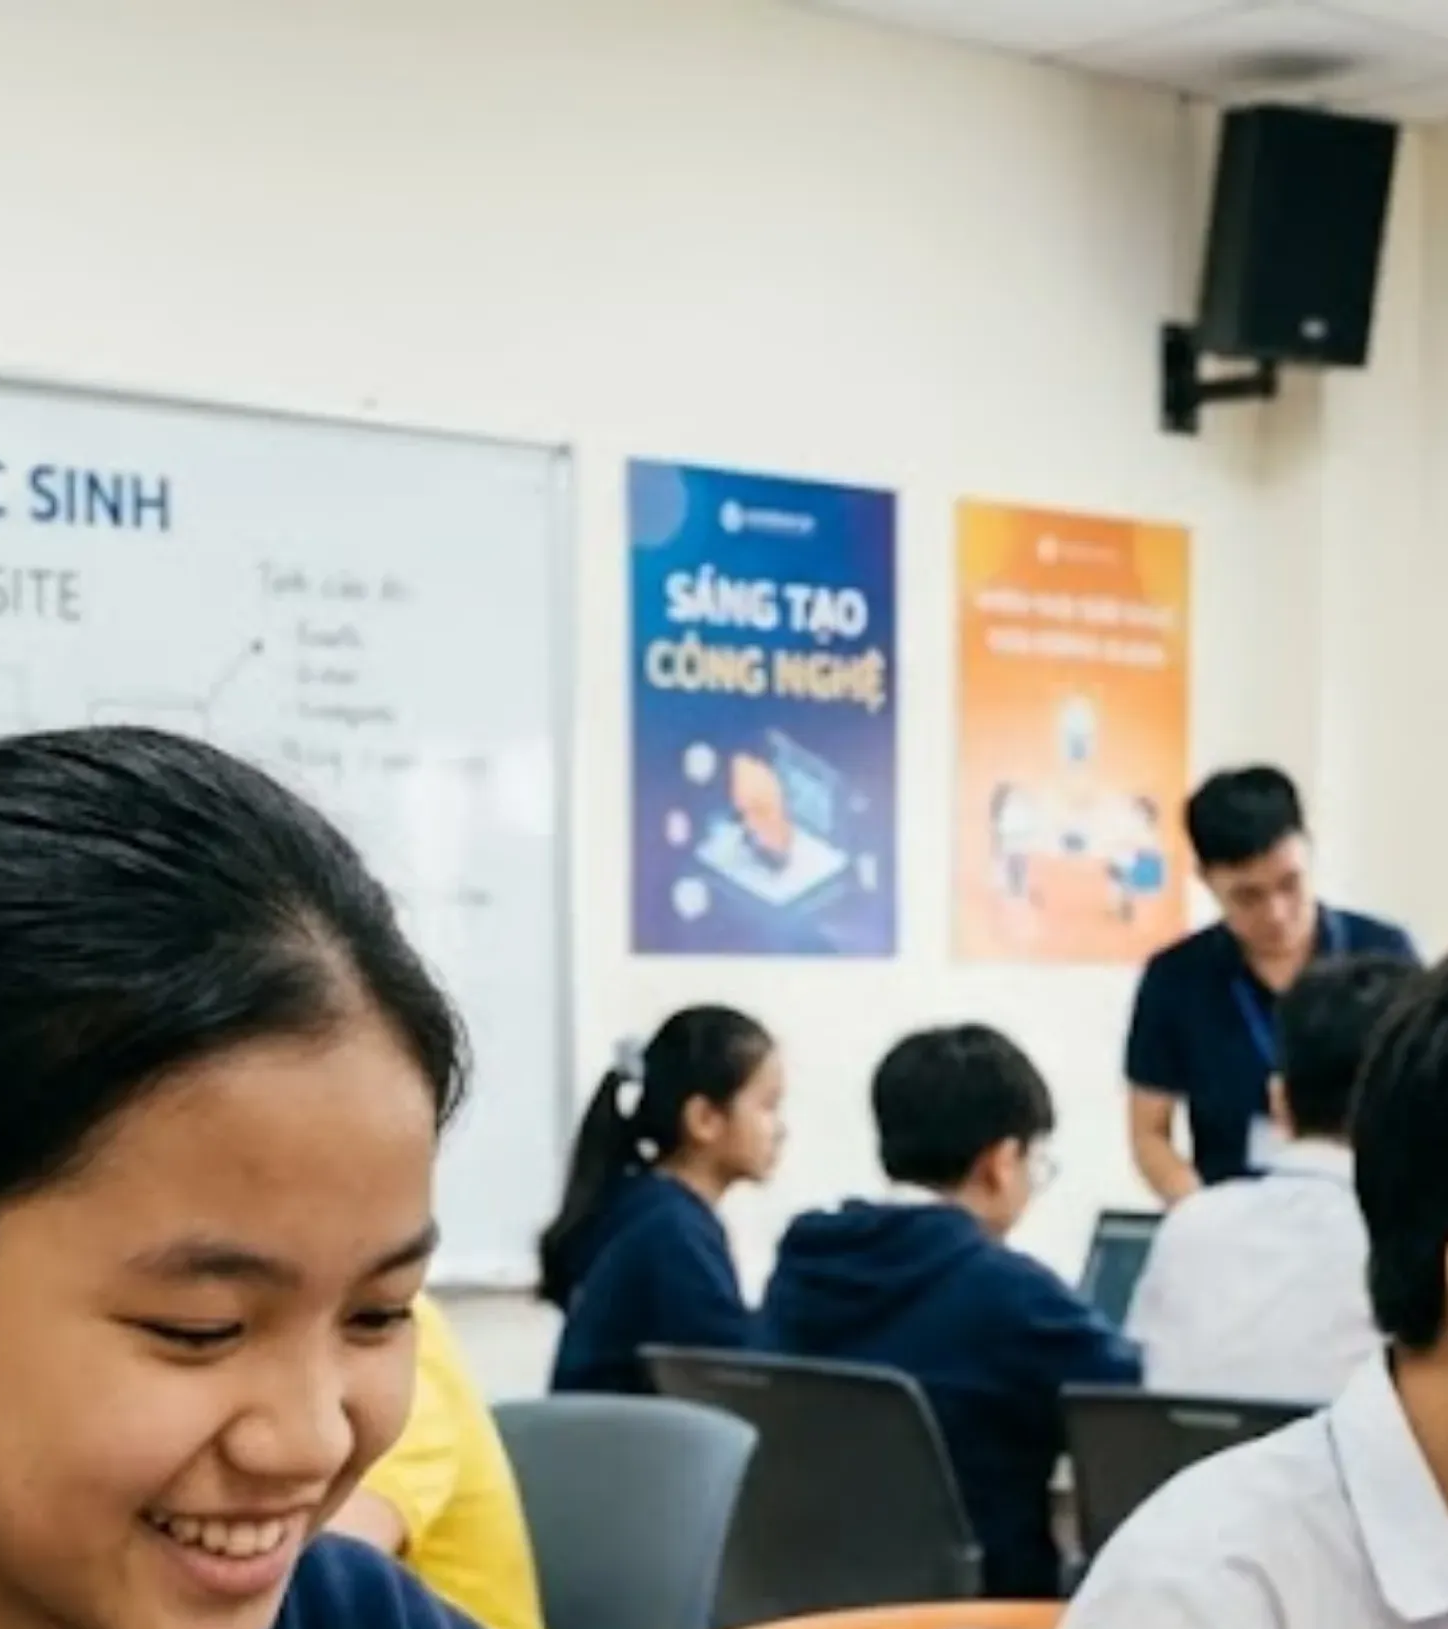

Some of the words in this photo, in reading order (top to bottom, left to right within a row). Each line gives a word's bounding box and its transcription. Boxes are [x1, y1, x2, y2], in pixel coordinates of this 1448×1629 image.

[30, 465, 169, 530] SINH
[665, 563, 778, 632] SÁNG
[784, 585, 867, 643] TẠO
[646, 631, 768, 695] CÔNG
